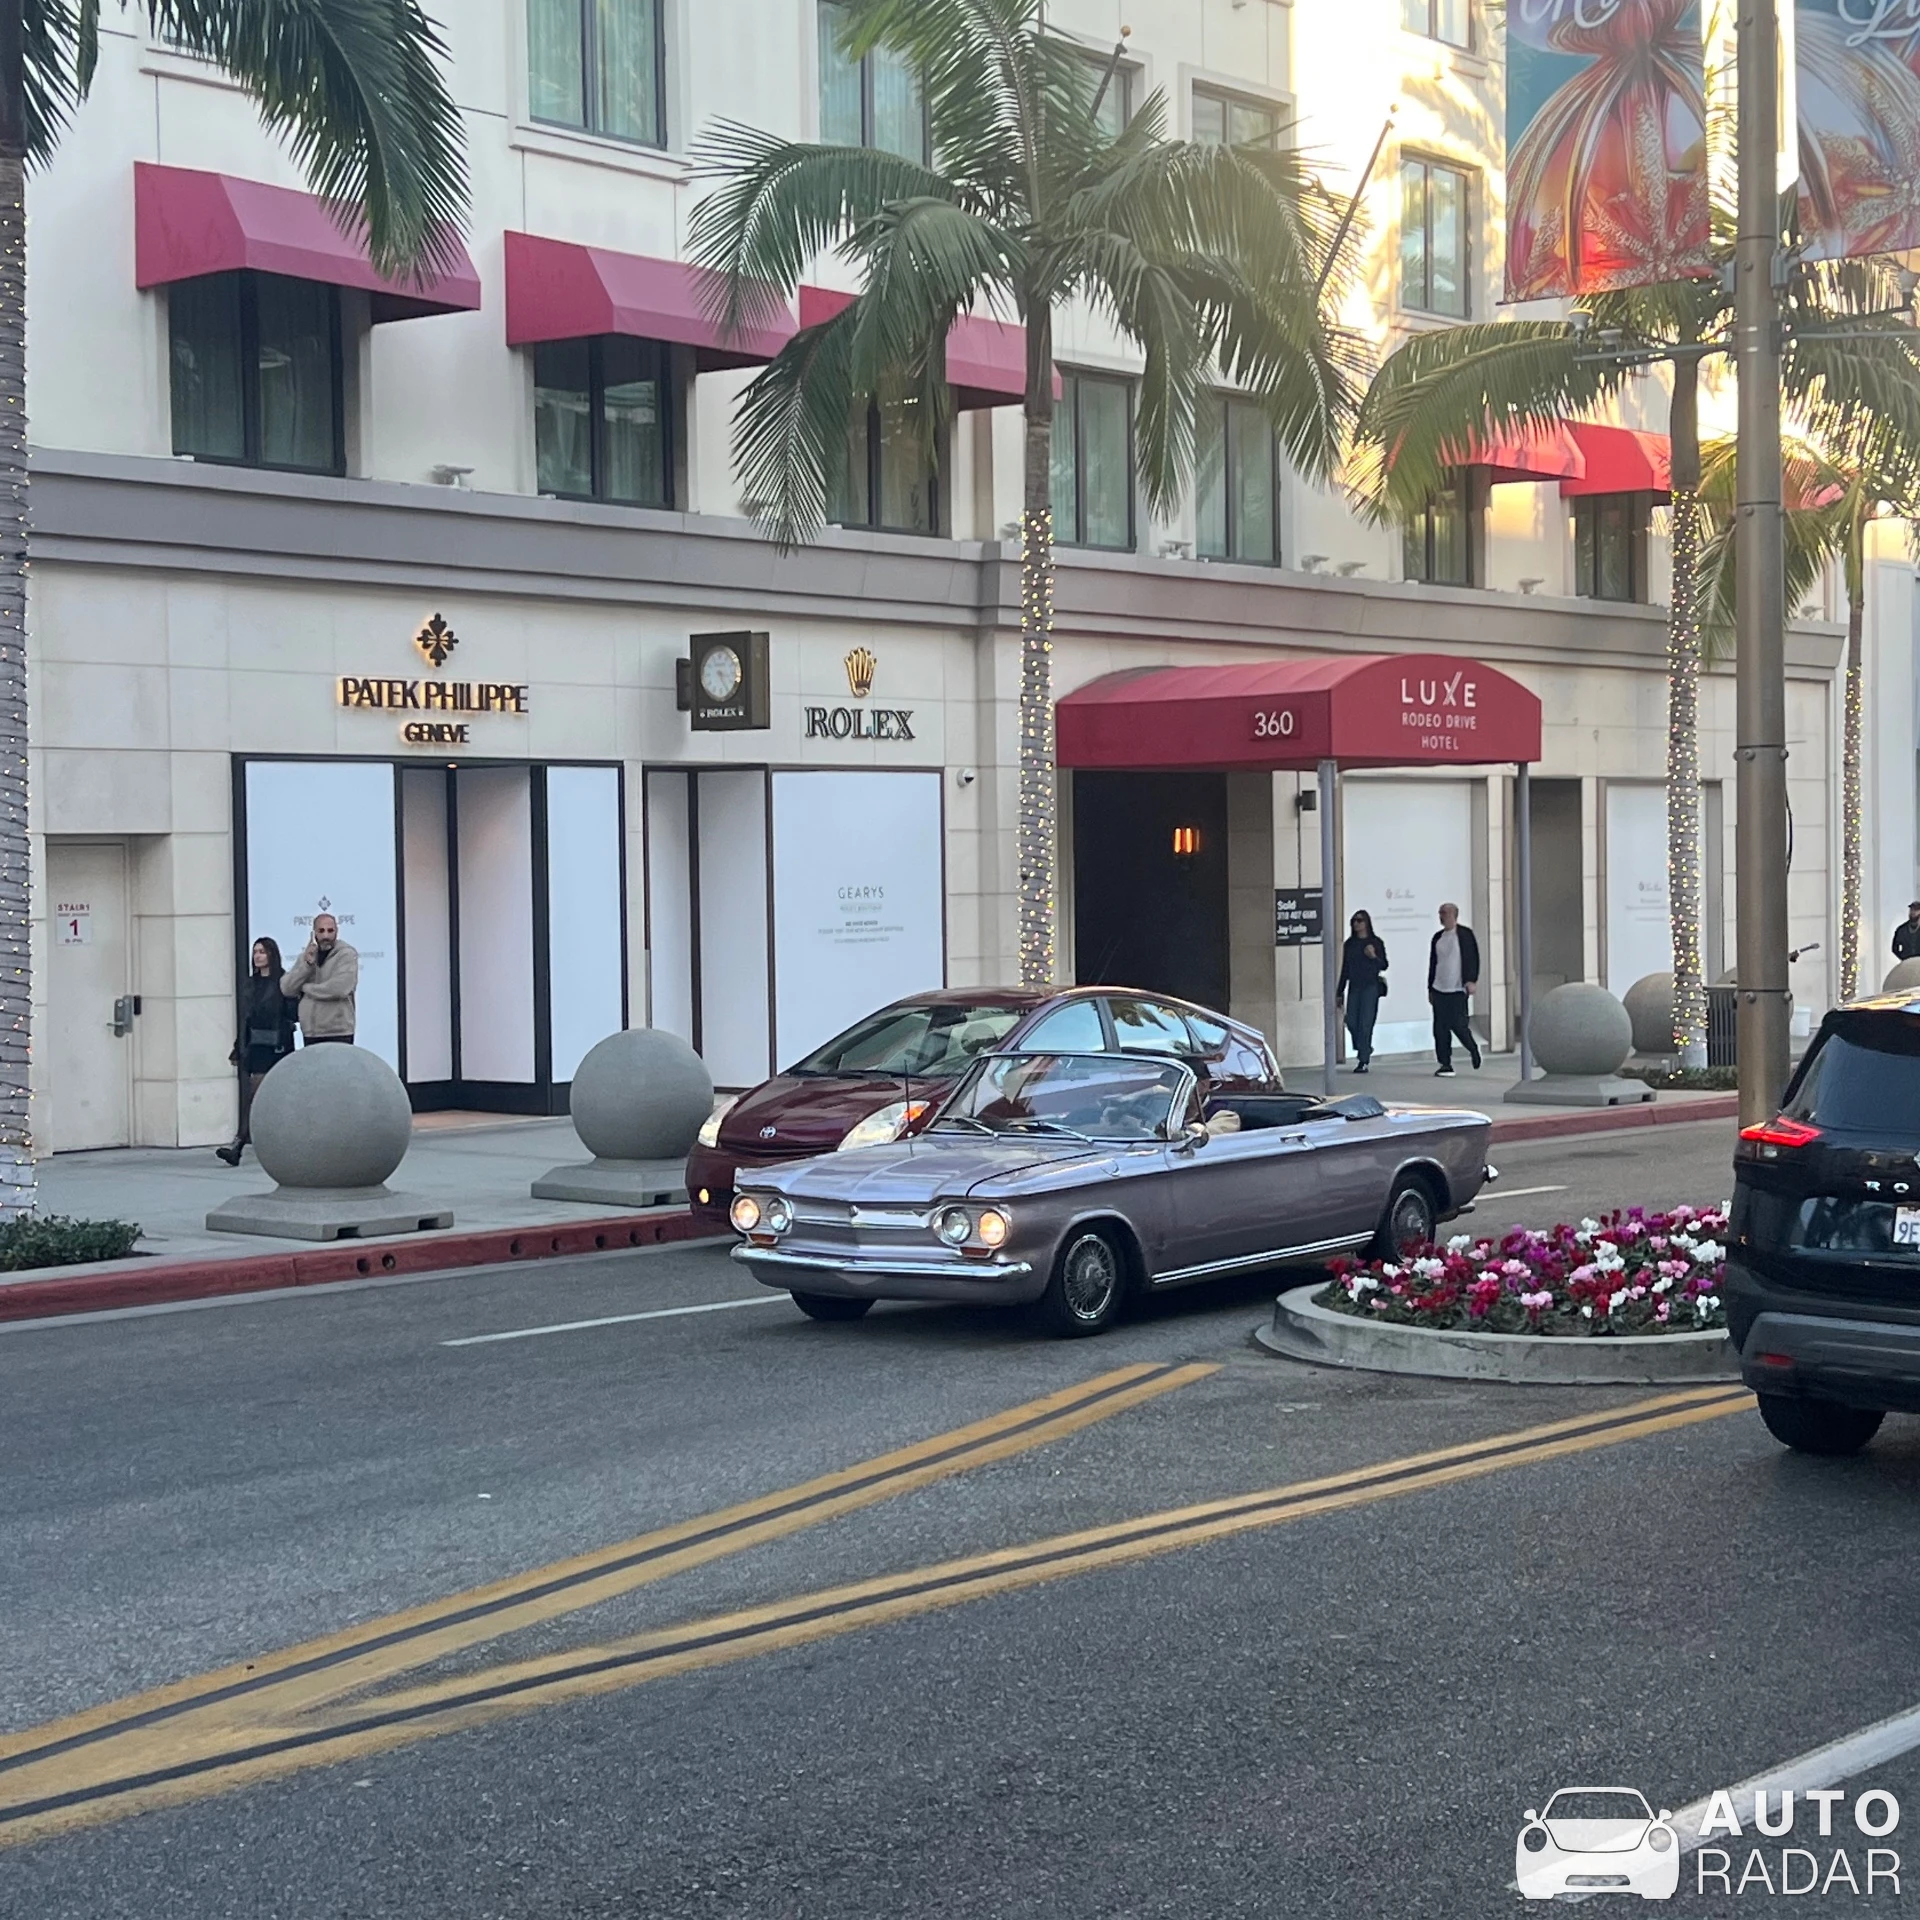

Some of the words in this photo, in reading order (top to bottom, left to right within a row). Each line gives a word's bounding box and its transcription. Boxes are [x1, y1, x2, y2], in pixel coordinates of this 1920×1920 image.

[342, 678, 420, 709] PATEK
[424, 681, 529, 713] PHILIPPE
[1401, 671, 1477, 707] LUXE
[707, 708, 736, 718] ROLEX
[1402, 712, 1441, 728] RODEO
[1446, 714, 1477, 730] DRIVE
[804, 706, 916, 740] ROLEX
[1254, 711, 1294, 736] 360
[404, 722, 470, 744] GENEVE
[1421, 735, 1459, 750] HOTEL
[838, 886, 884, 899] GEARYS
[69, 919, 78, 936] 1
[293, 916, 314, 926] PATE
